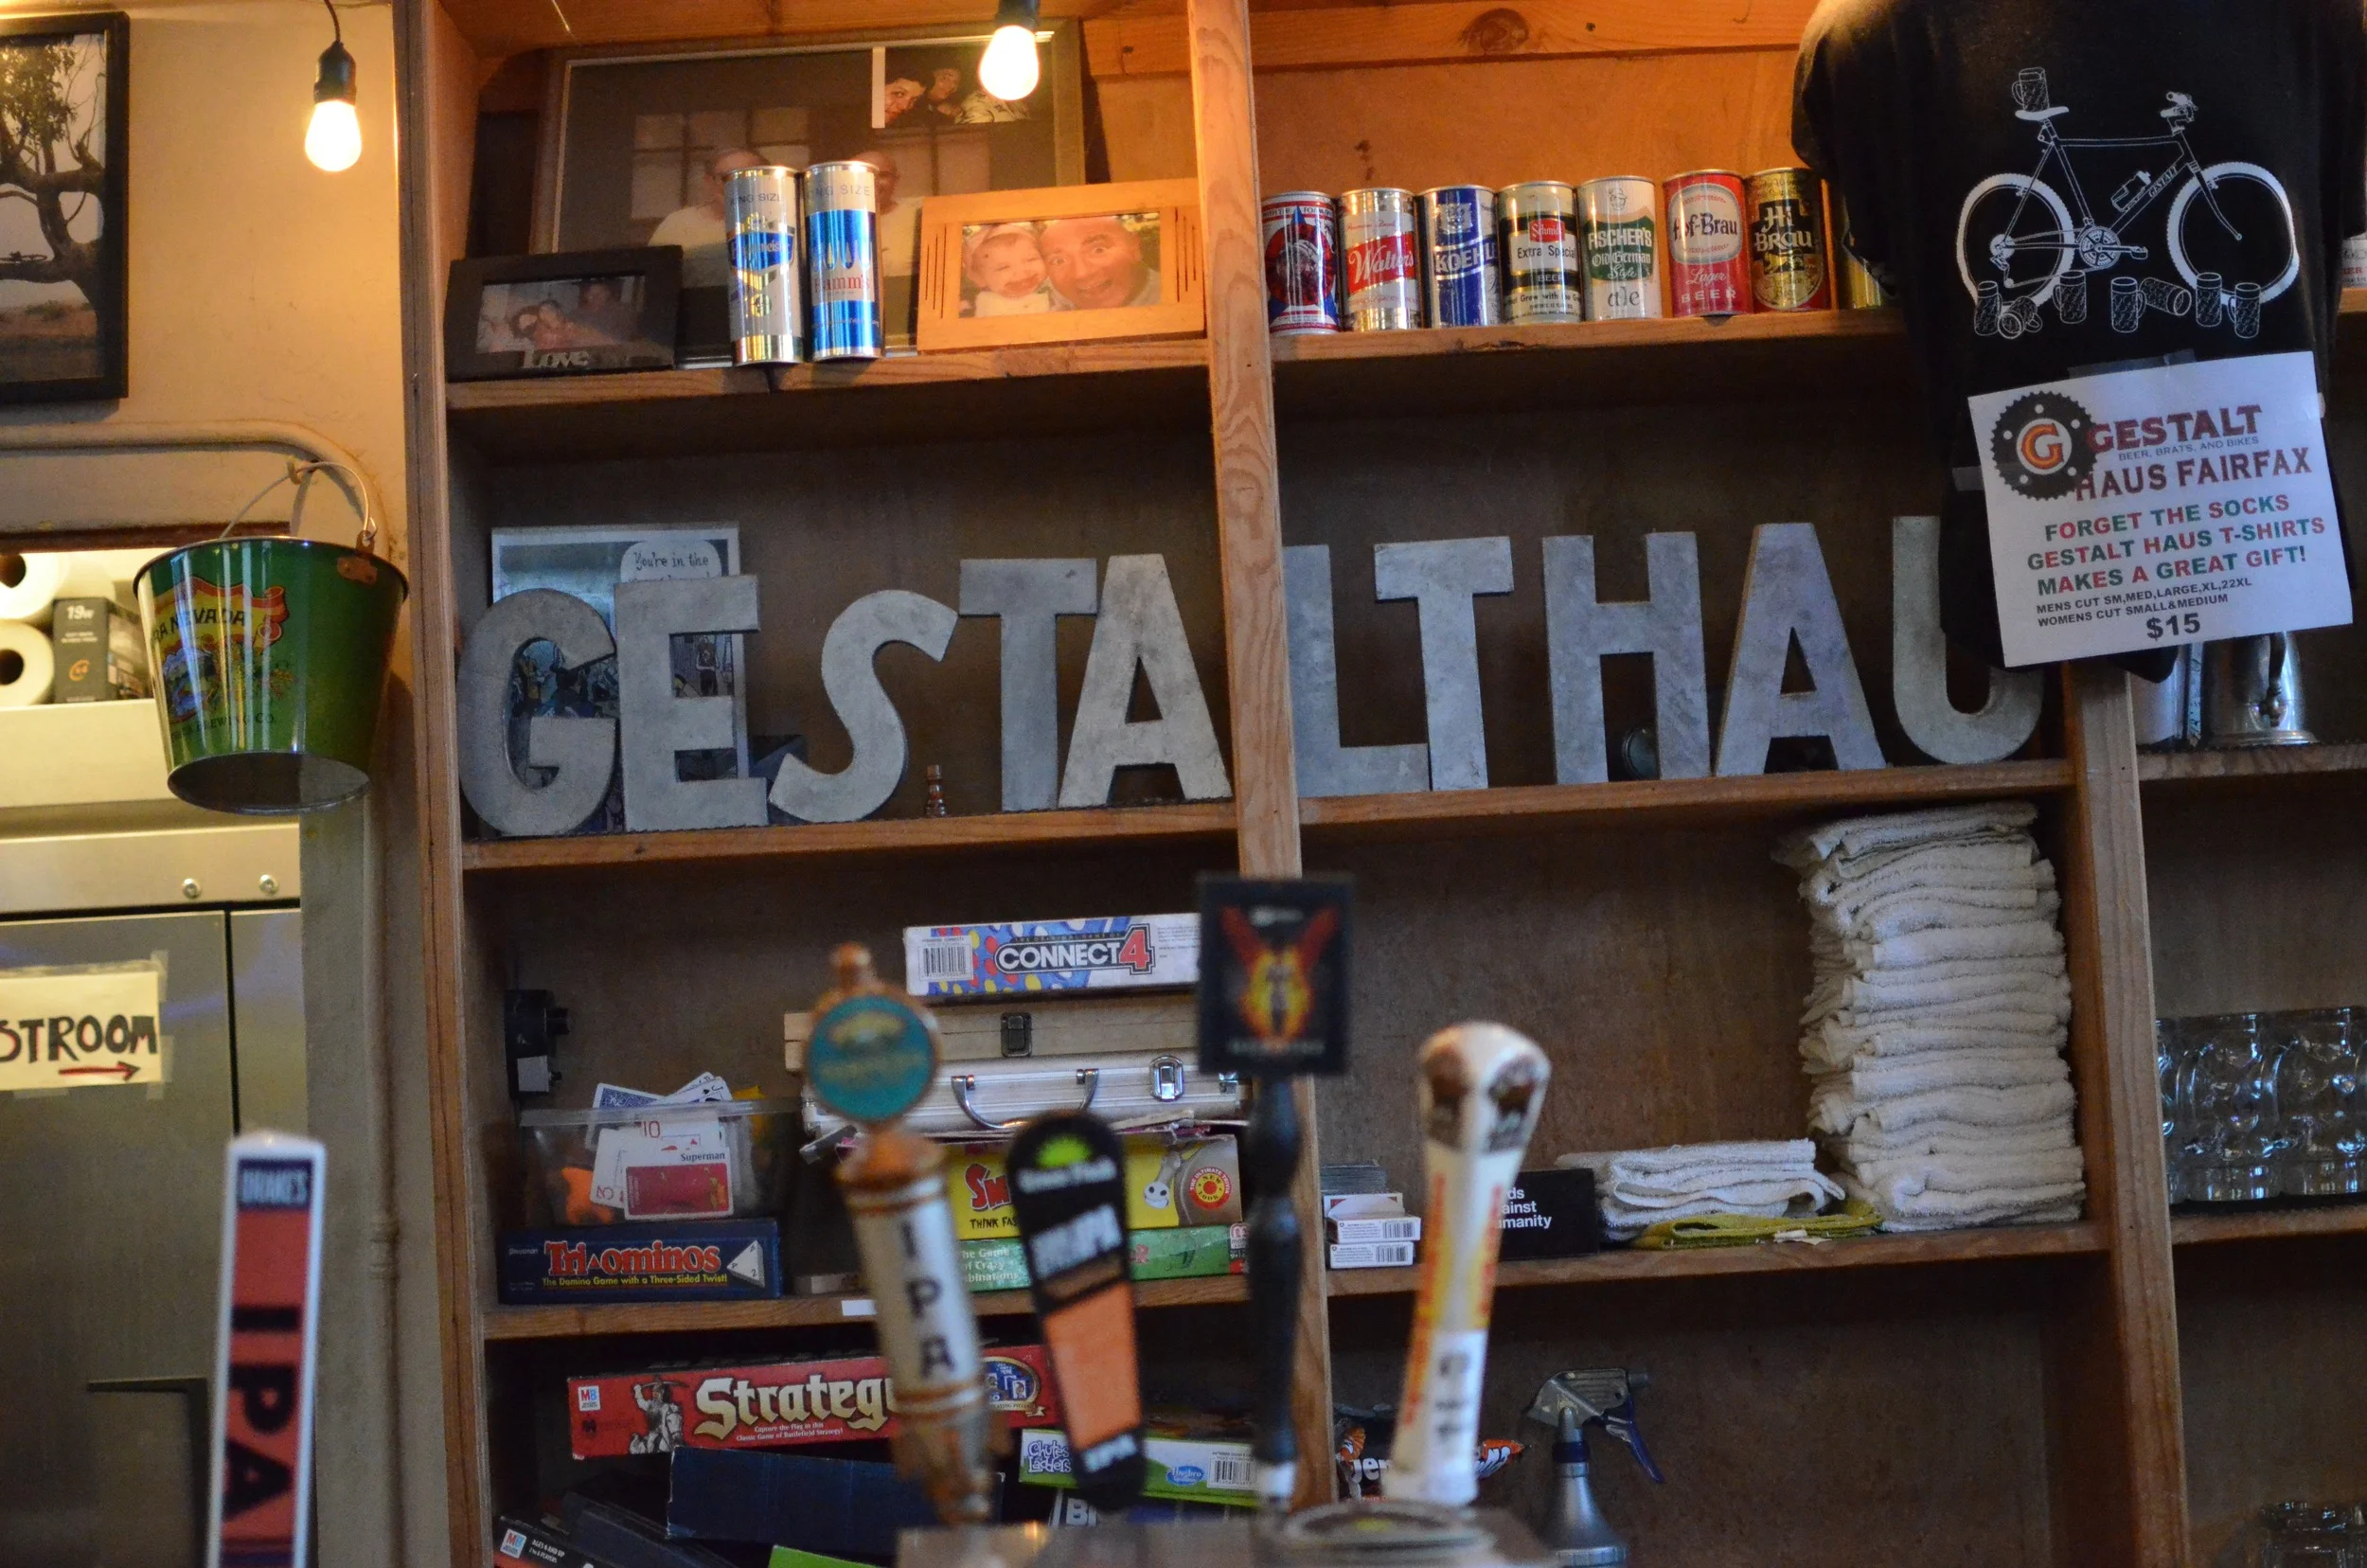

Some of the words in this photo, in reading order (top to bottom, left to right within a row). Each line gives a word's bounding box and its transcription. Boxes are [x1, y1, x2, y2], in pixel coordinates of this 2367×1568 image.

[841, 184, 871, 197] SIZE
[2148, 165, 2179, 198] GESTALT
[1517, 247, 1542, 259] Extra
[1348, 243, 1415, 284] Walter's
[1607, 286, 1640, 307] ale
[1681, 289, 1736, 304] BEER
[2086, 403, 2263, 455] GESTALT
[2020, 422, 2065, 471] G
[2118, 449, 2150, 462] BEER,
[2155, 444, 2198, 457] BRATS,
[2200, 438, 2225, 452] AND
[2226, 436, 2259, 448] BIKES
[2075, 462, 2168, 503] HAUS
[2178, 446, 2313, 489] FAIRFAX
[2045, 511, 2143, 543] FORGET
[2150, 504, 2201, 526] THE
[2209, 493, 2290, 519] SOCKS
[2027, 540, 2135, 571] GESTALT
[2144, 529, 2213, 555] HAUS
[2219, 516, 2325, 543] T-SHIRTS
[633, 551, 668, 571] You're
[671, 551, 685, 567] in
[689, 550, 709, 567] the
[2038, 569, 2124, 597] MAKES
[2131, 565, 2149, 583] A
[2156, 552, 2237, 579] GREAT
[2246, 544, 2306, 568] GIFT!
[2037, 600, 2072, 615] MENS
[2074, 597, 2100, 610] CUT
[169, 606, 246, 633] NVADA
[2038, 611, 2093, 628] WOMENS
[2095, 608, 2121, 620] CUT
[2145, 612, 2201, 641] $15
[998, 941, 1121, 971] CONNECT
[1119, 929, 1150, 970] 4
[680, 1152, 725, 1163] Superman
[1202, 1175, 1221, 1185] NEW
[970, 1217, 999, 1229] THINK
[979, 1246, 1010, 1258] Game
[975, 1259, 1006, 1272] Crazy
[543, 1277, 558, 1287] The
[560, 1276, 592, 1286] Domino
[594, 1276, 618, 1286] Game
[621, 1275, 640, 1285] with
[650, 1274, 701, 1284] Three-Sided
[703, 1274, 728, 1283] Twist!
[901, 1220, 957, 1377] IPA
[580, 1388, 597, 1401] MB
[223, 1305, 301, 1523] IPA
[754, 1425, 779, 1434] Capture
[1028, 1439, 1069, 1458] Chutes
[1028, 1455, 1072, 1474] Ladders
[1171, 1467, 1202, 1480] Hasbro
[532, 1539, 544, 1549] AGES
[548, 1545, 559, 1556] AND
